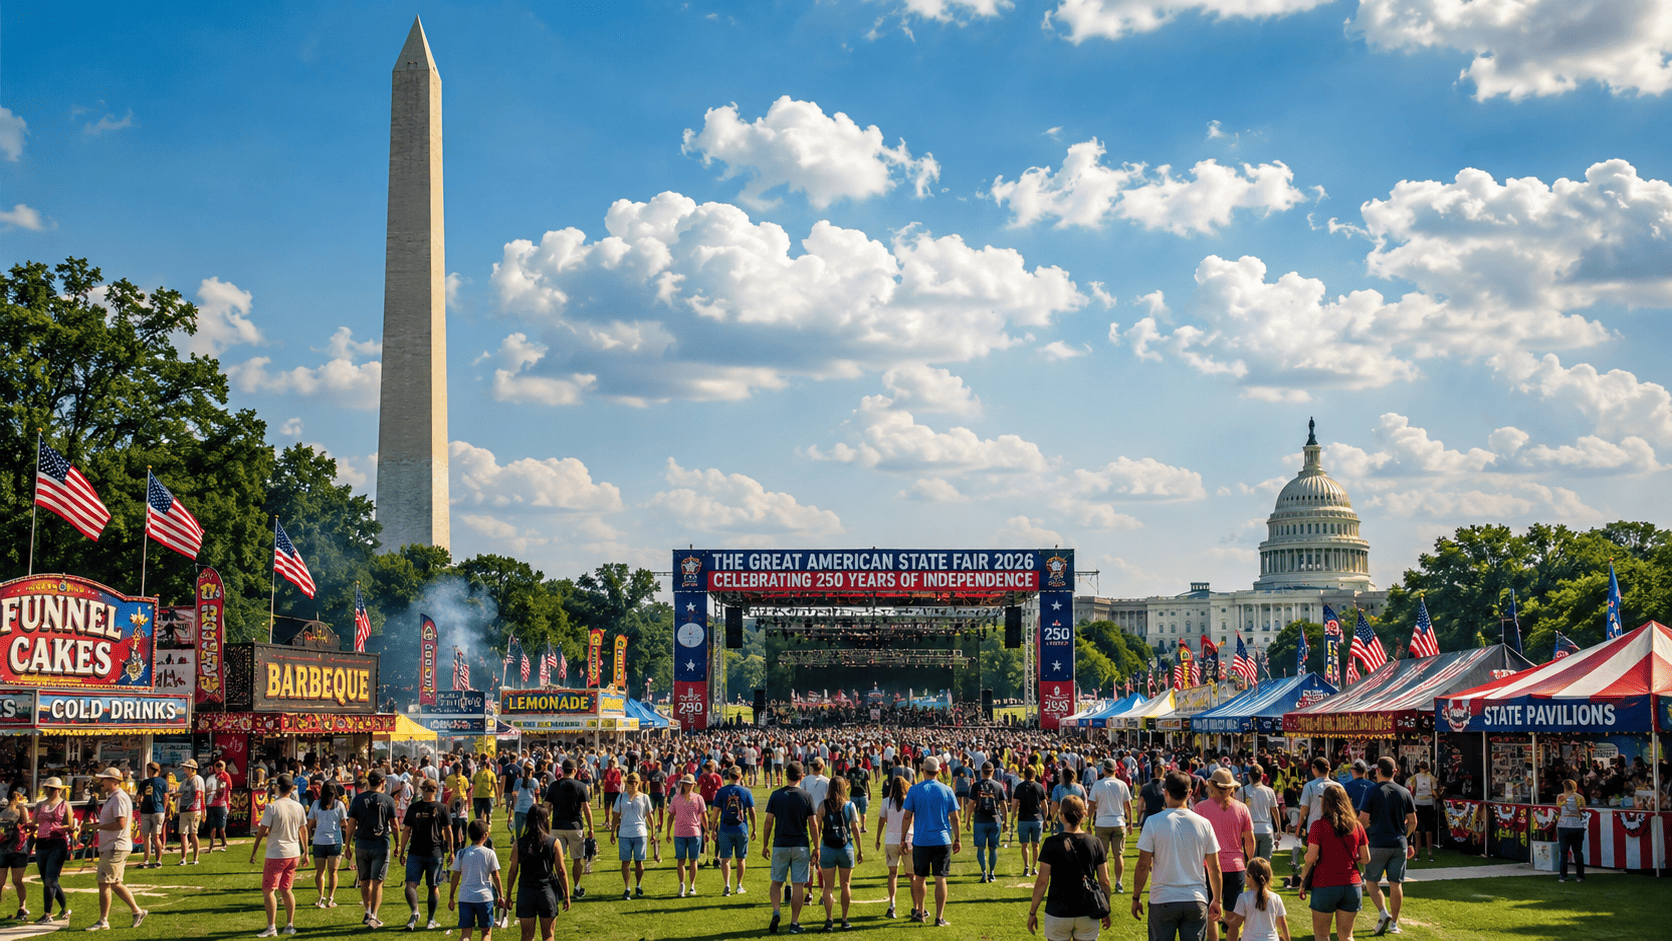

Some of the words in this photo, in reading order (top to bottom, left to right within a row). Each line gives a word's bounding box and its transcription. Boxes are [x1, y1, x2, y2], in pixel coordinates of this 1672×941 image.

[712, 553, 744, 570] THE
[749, 553, 802, 570] GREAT
[806, 553, 893, 570] AMERICAN
[898, 553, 948, 570] STATE
[953, 553, 989, 570] FAIR
[994, 553, 1034, 570] 2026
[713, 572, 812, 588] CELEBRATING
[816, 572, 843, 588] 250
[848, 572, 896, 588] YEARS
[900, 572, 918, 588] OF
[923, 572, 1034, 588] INDEPENDENCE
[1, 594, 122, 642] FUNNEL
[1044, 627, 1070, 641] 250
[9, 636, 112, 678] CAKES
[265, 661, 370, 706] BARBEQUE
[51, 699, 103, 719] COLD
[110, 700, 176, 720] DRINKS
[509, 696, 589, 710] LEMONADE
[1484, 704, 1522, 726] STATE
[1526, 703, 1616, 727] PAVILIONS
